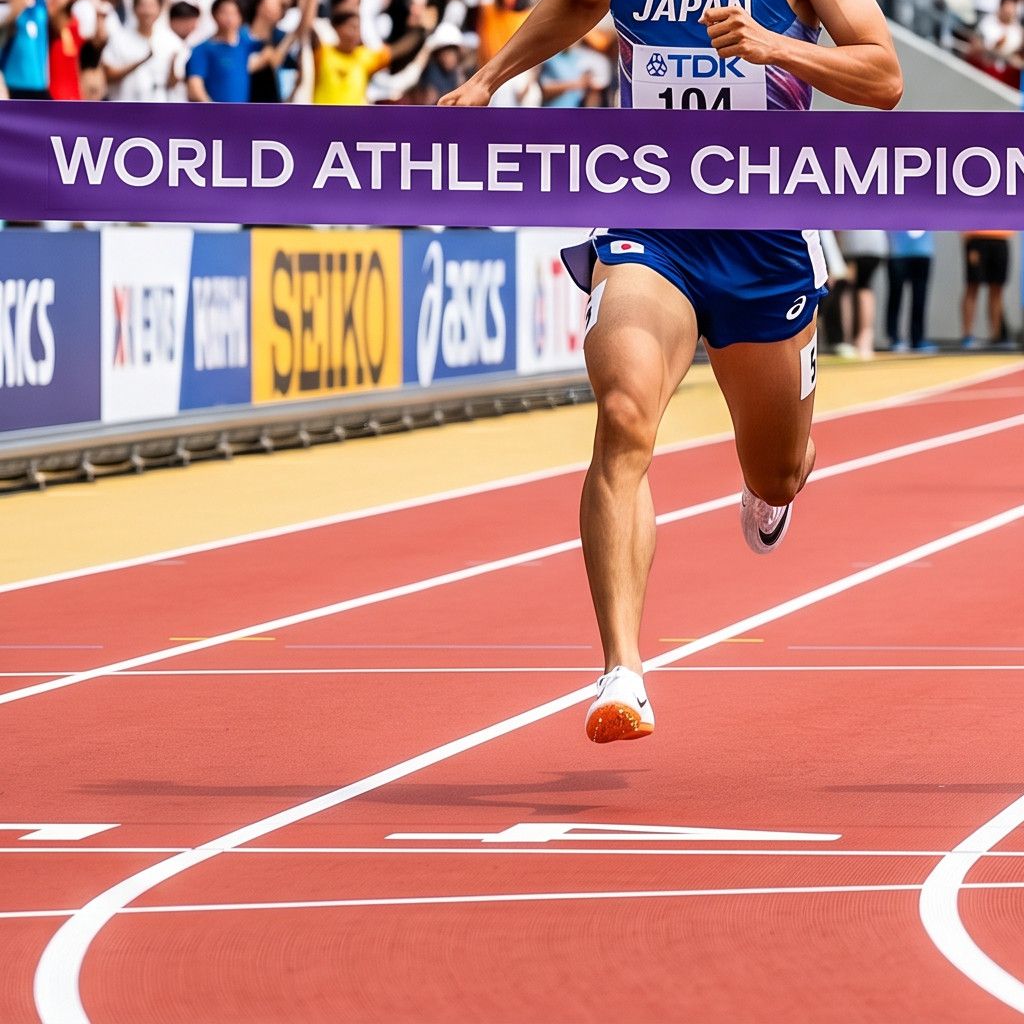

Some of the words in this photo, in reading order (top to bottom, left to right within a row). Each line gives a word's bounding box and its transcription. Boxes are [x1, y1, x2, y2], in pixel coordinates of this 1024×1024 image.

[668, 54, 746, 79] TDK
[51, 137, 296, 188] WORLD
[313, 142, 672, 195] ATHLETICS
[0, 277, 56, 389] sics
[271, 249, 387, 396] SEIKO
[442, 259, 507, 368] asics
[384, 823, 843, 844] 4
